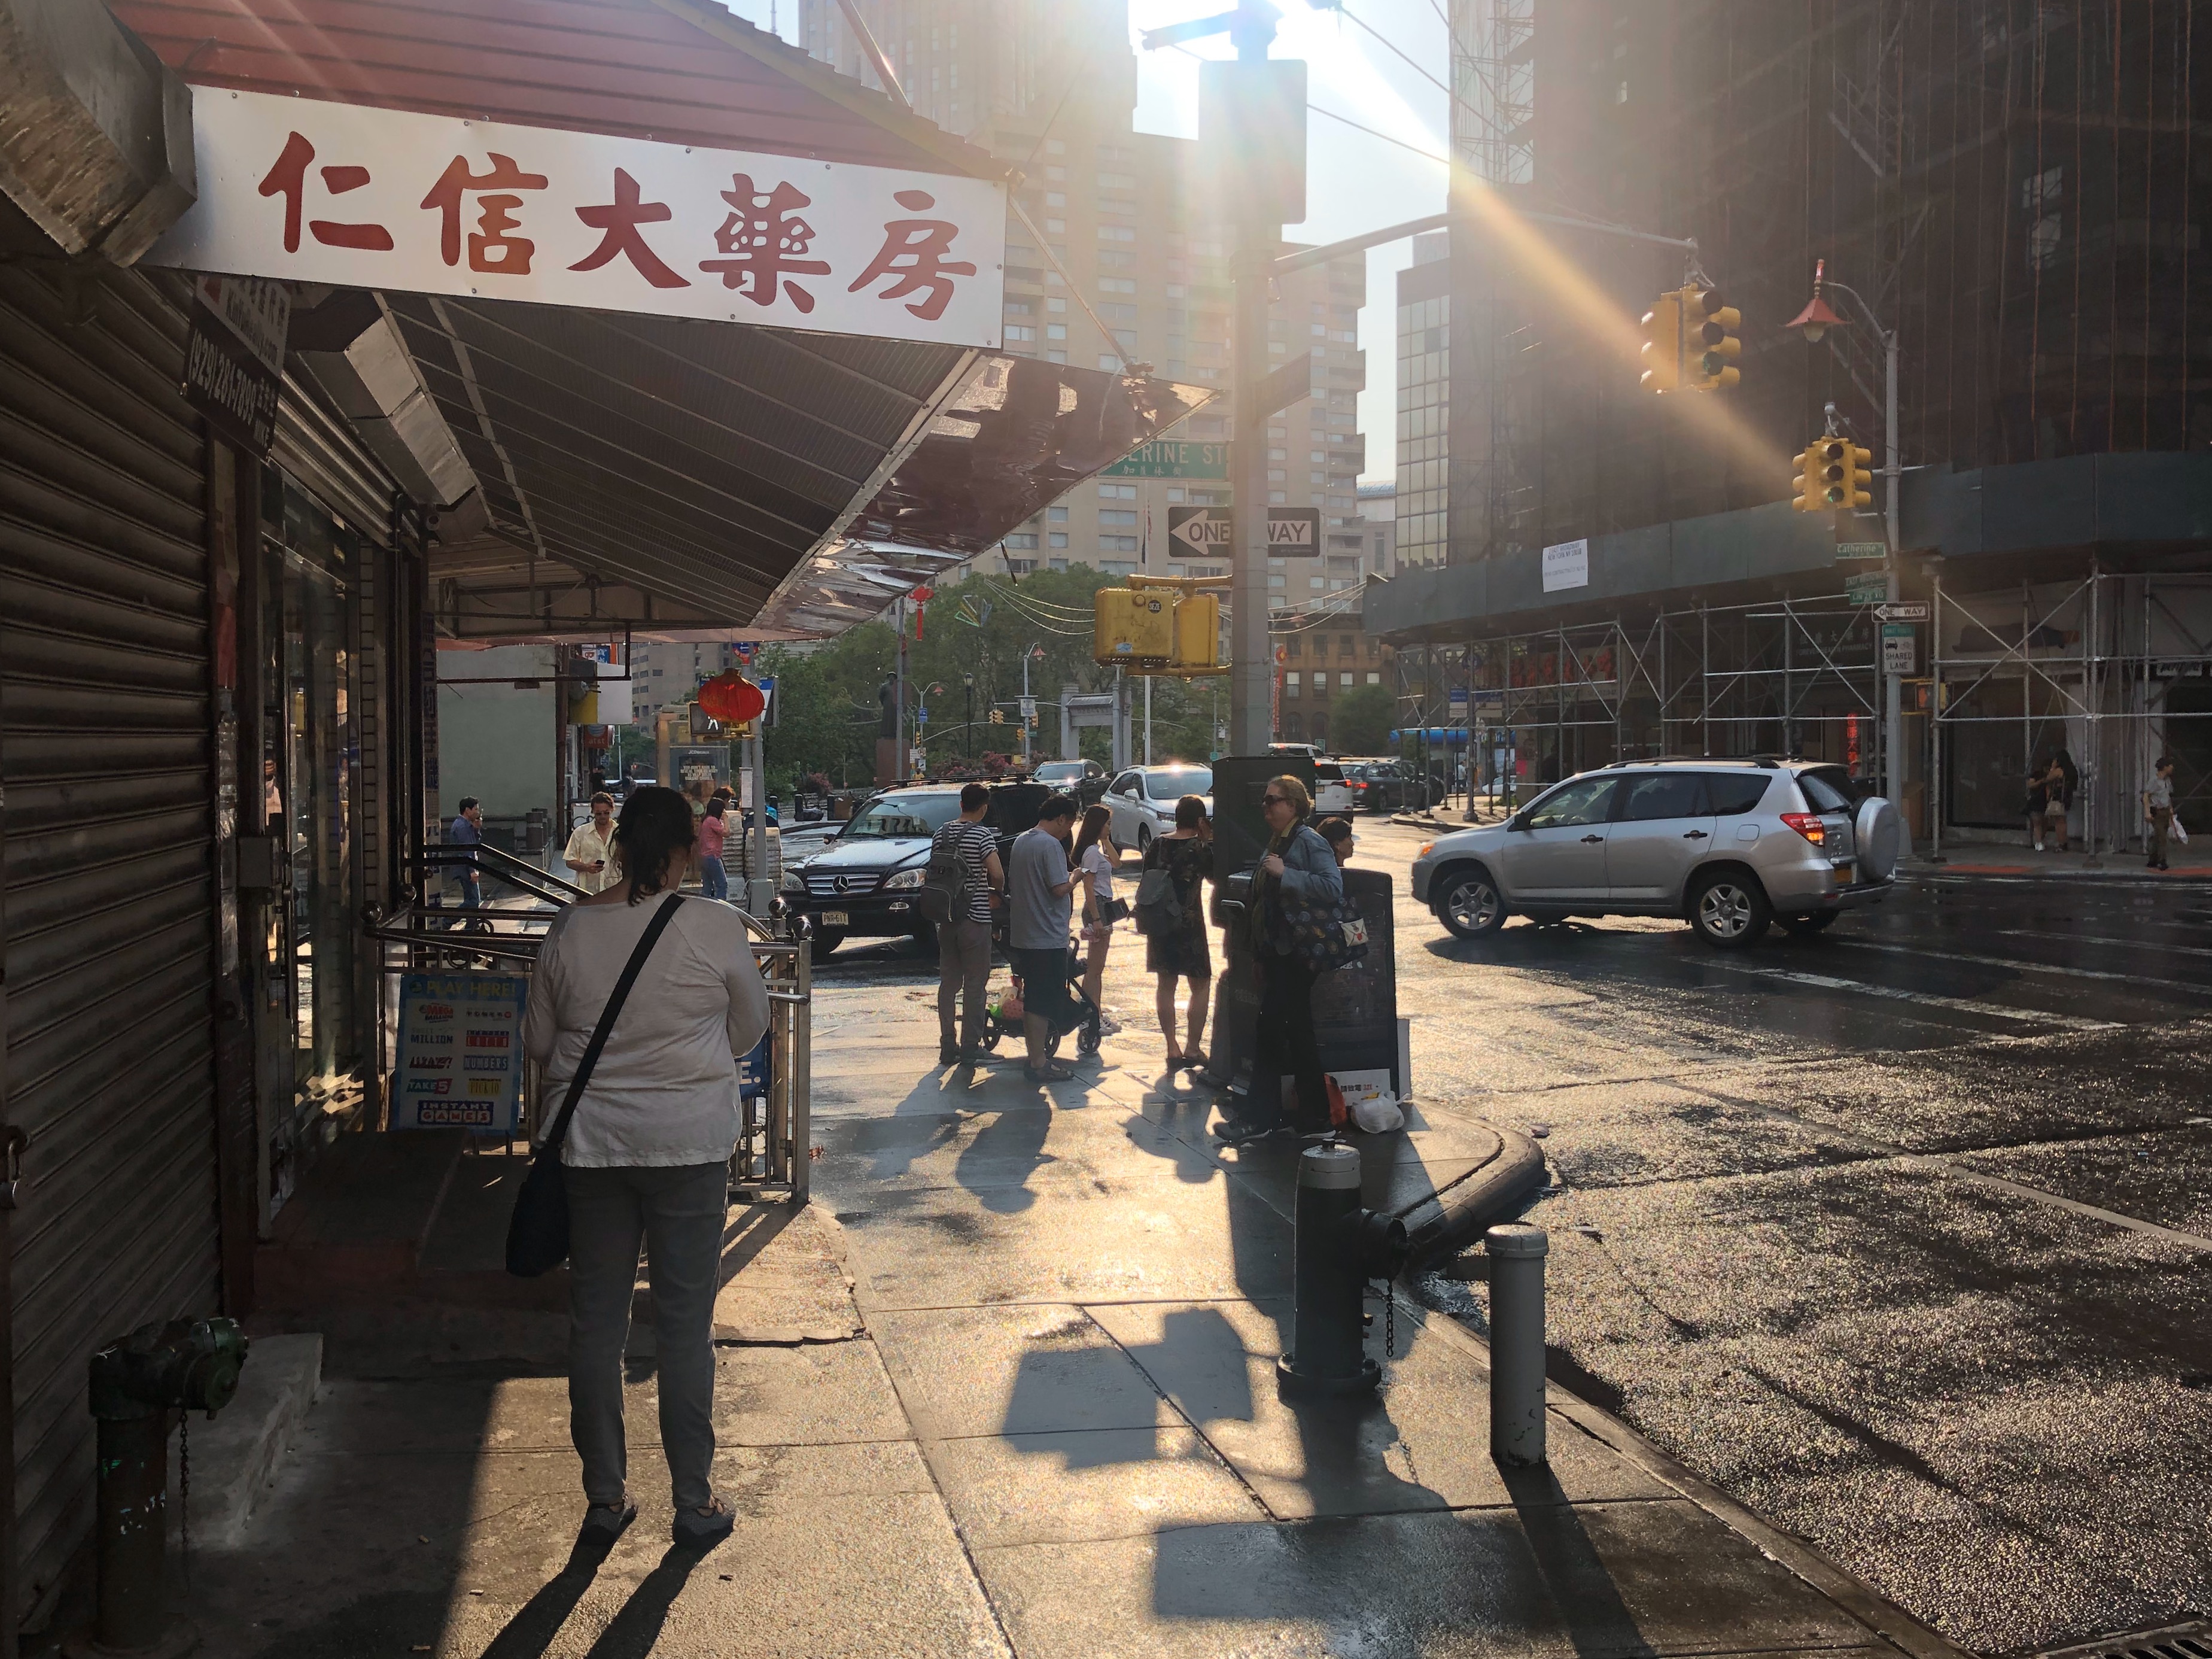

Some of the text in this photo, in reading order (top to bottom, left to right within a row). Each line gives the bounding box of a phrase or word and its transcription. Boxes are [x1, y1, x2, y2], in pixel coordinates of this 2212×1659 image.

[258, 131, 976, 321] 仁信大藥房
[1203, 445, 1224, 465] ST
[1189, 522, 1230, 542] ONE
[1837, 544, 1876, 553] Catherine
[1885, 652, 1913, 661] SHARED
[427, 980, 516, 998] PLAY HERE!
[427, 1005, 454, 1016] MEGA
[410, 1034, 454, 1044] MILLION
[468, 1037, 508, 1046] LOTTO
[464, 1057, 507, 1069] NUMBERS
[409, 1081, 436, 1090] TAKE
[422, 1111, 489, 1121] GAMES
